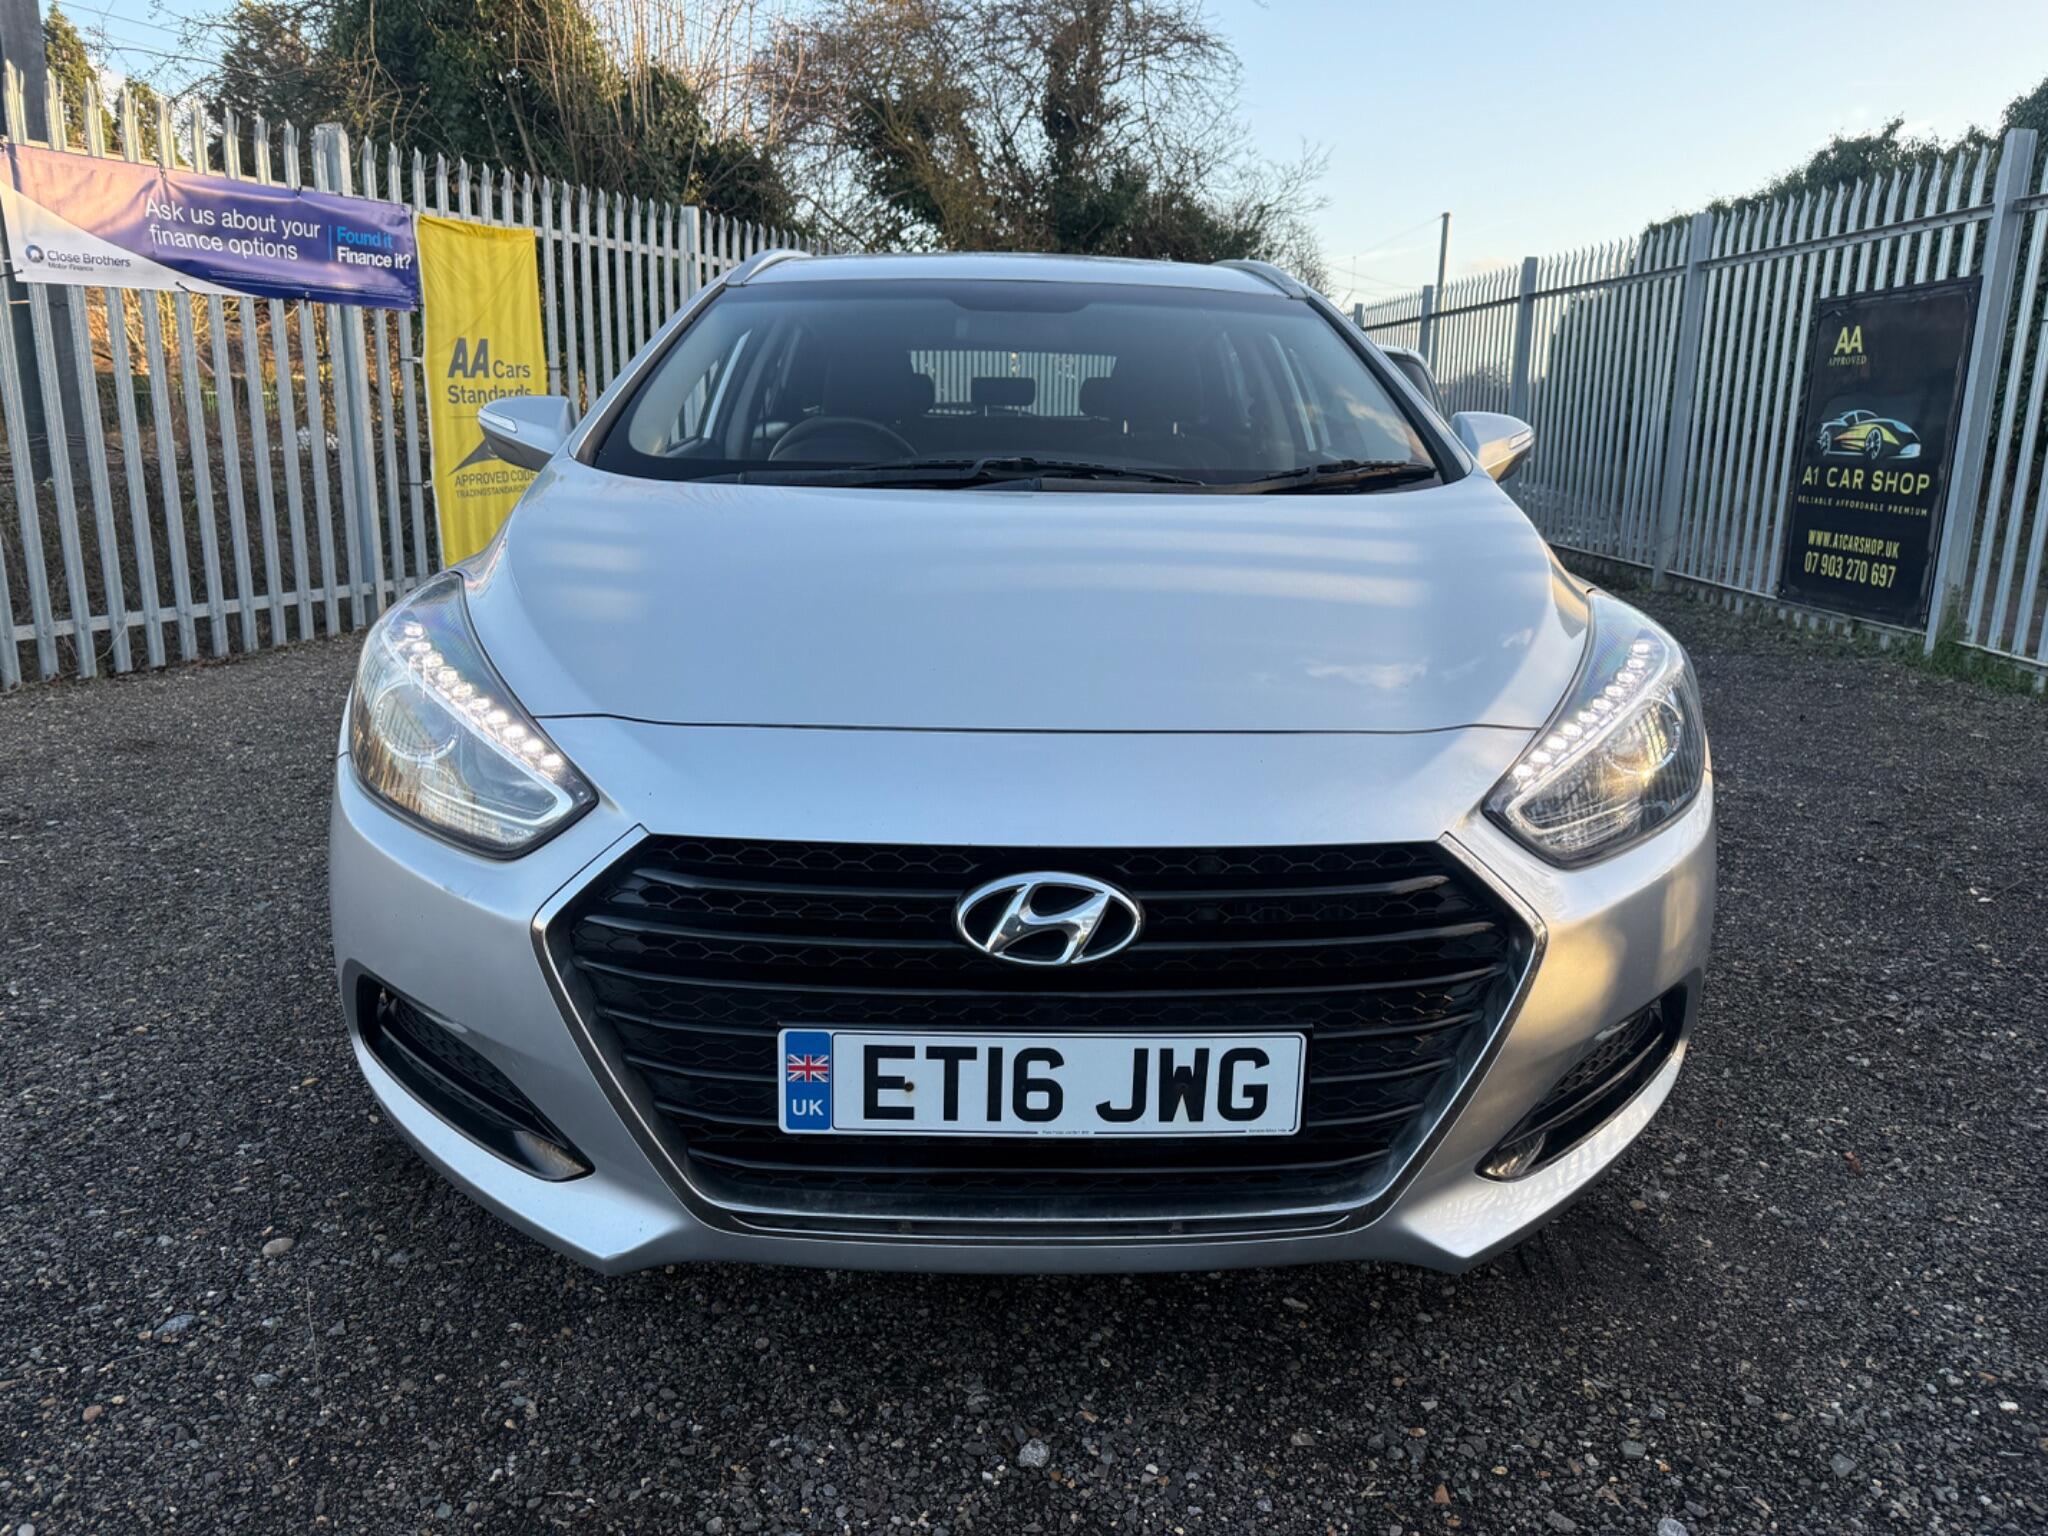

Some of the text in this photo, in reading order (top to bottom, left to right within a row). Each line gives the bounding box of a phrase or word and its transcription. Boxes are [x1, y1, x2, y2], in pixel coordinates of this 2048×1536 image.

[145, 198, 321, 240] Ask us about your
[149, 224, 299, 261] finance options
[336, 226, 393, 249] Found it
[47, 250, 131, 268] Close Brothers
[48, 262, 94, 272] Motor Finance
[336, 246, 411, 270] Finance it?
[1833, 325, 1863, 355] AA
[447, 337, 531, 379] AA Cars
[1828, 355, 1867, 367] APPROVED
[455, 471, 510, 487] APPROVED
[1802, 465, 1930, 496] A1 CAR SHOP
[1797, 495, 1928, 517] RELIABLE AFFORDABLE PREMIUM
[1807, 529, 1900, 559] WWW.A1CARSHOP.UK
[1804, 551, 1897, 588] 07 903 270 697
[792, 1044, 1271, 1123] UK ET16 JWG
